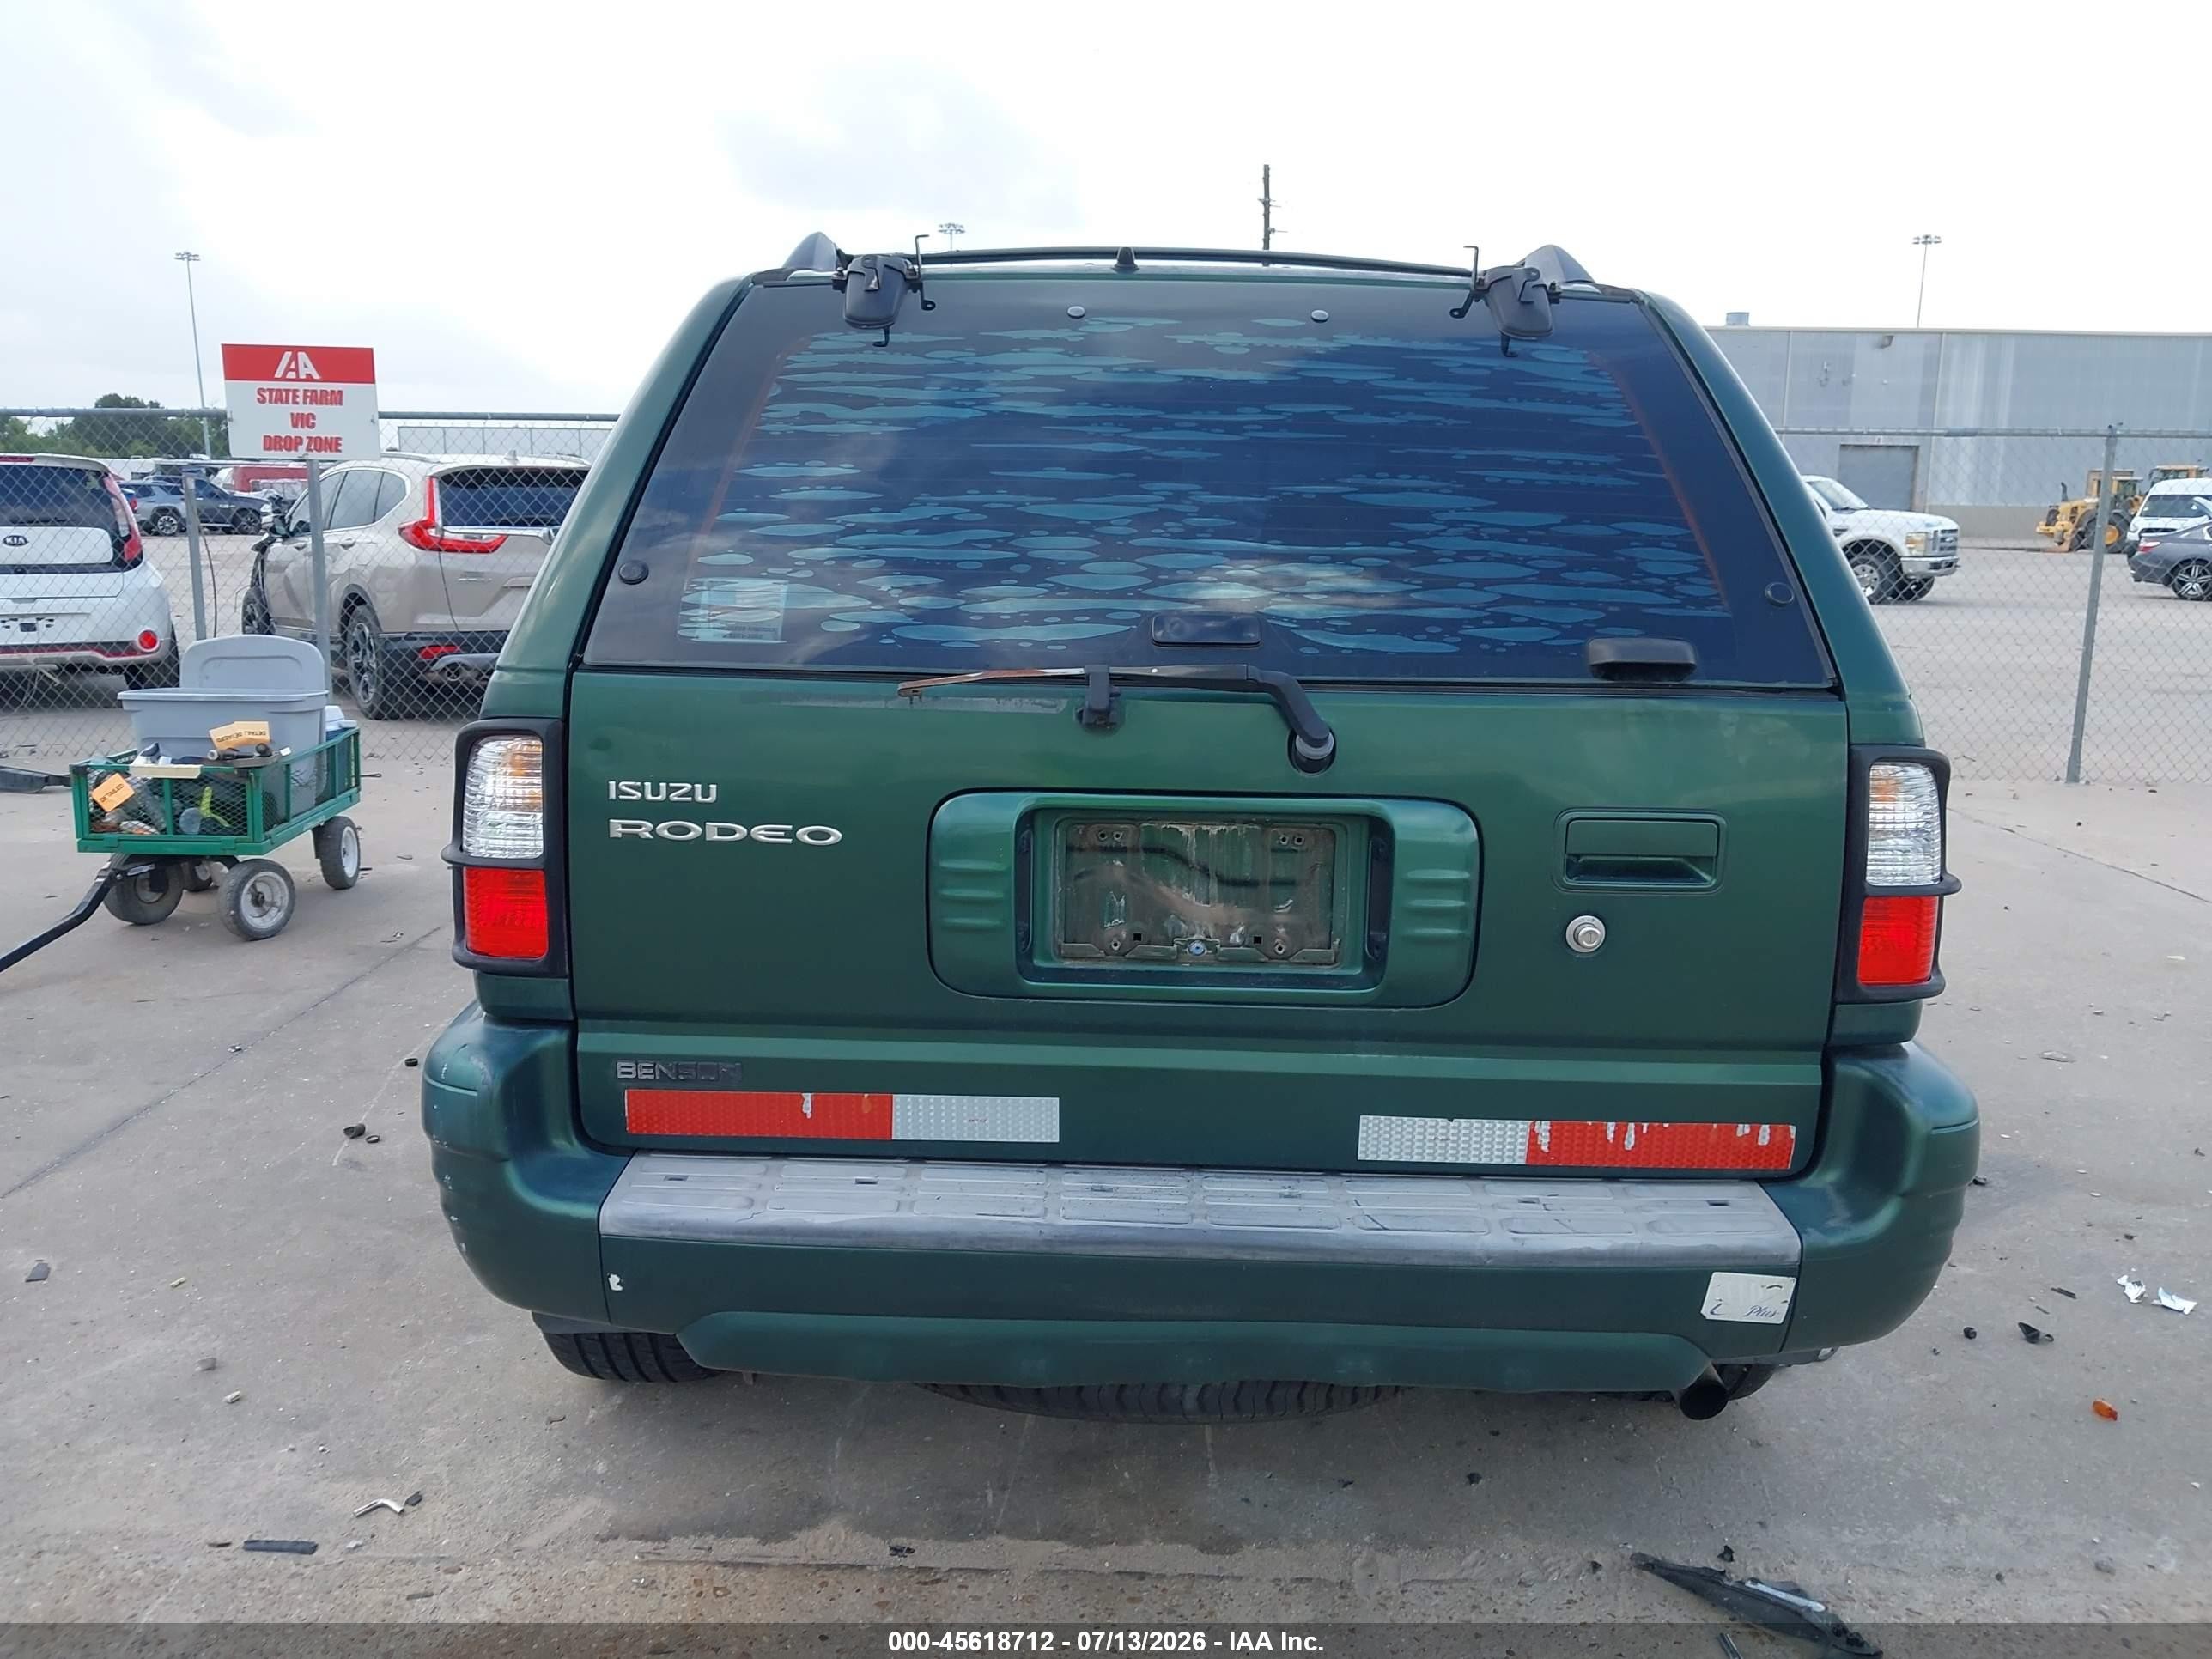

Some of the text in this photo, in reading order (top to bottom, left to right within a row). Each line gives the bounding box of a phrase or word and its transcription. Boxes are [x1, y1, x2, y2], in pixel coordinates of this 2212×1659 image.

[257, 387, 343, 406] STATE FARM
[290, 412, 316, 429] VIC
[263, 434, 342, 453] DROP ZONE
[5, 536, 27, 545] KIA
[99, 783, 125, 803] DETAILED
[608, 781, 718, 803] ISUZU
[609, 818, 842, 845] RODEO
